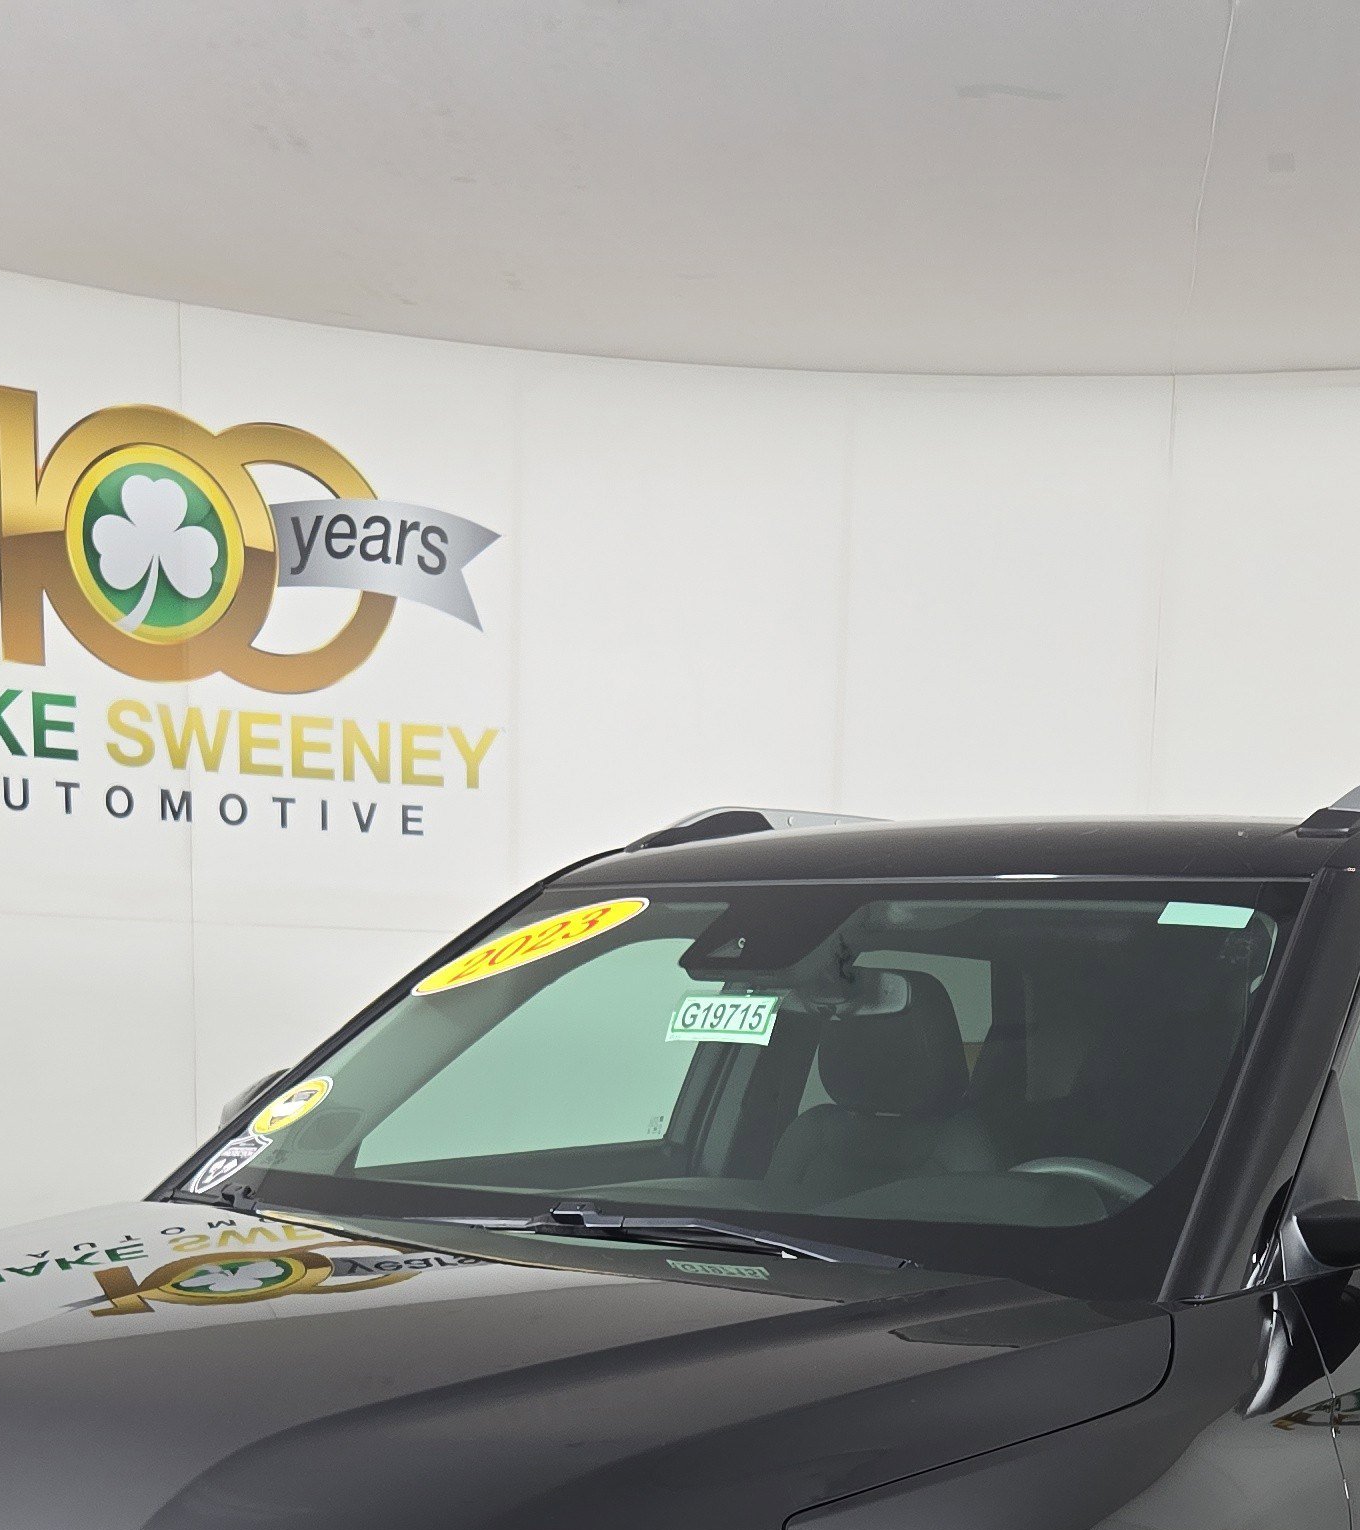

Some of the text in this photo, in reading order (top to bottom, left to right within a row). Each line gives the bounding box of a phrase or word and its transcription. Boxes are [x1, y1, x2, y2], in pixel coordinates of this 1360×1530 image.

[290, 512, 449, 576] years
[105, 699, 499, 790] SWEENEY
[446, 907, 612, 985] 2023
[681, 1002, 767, 1031] G19715
